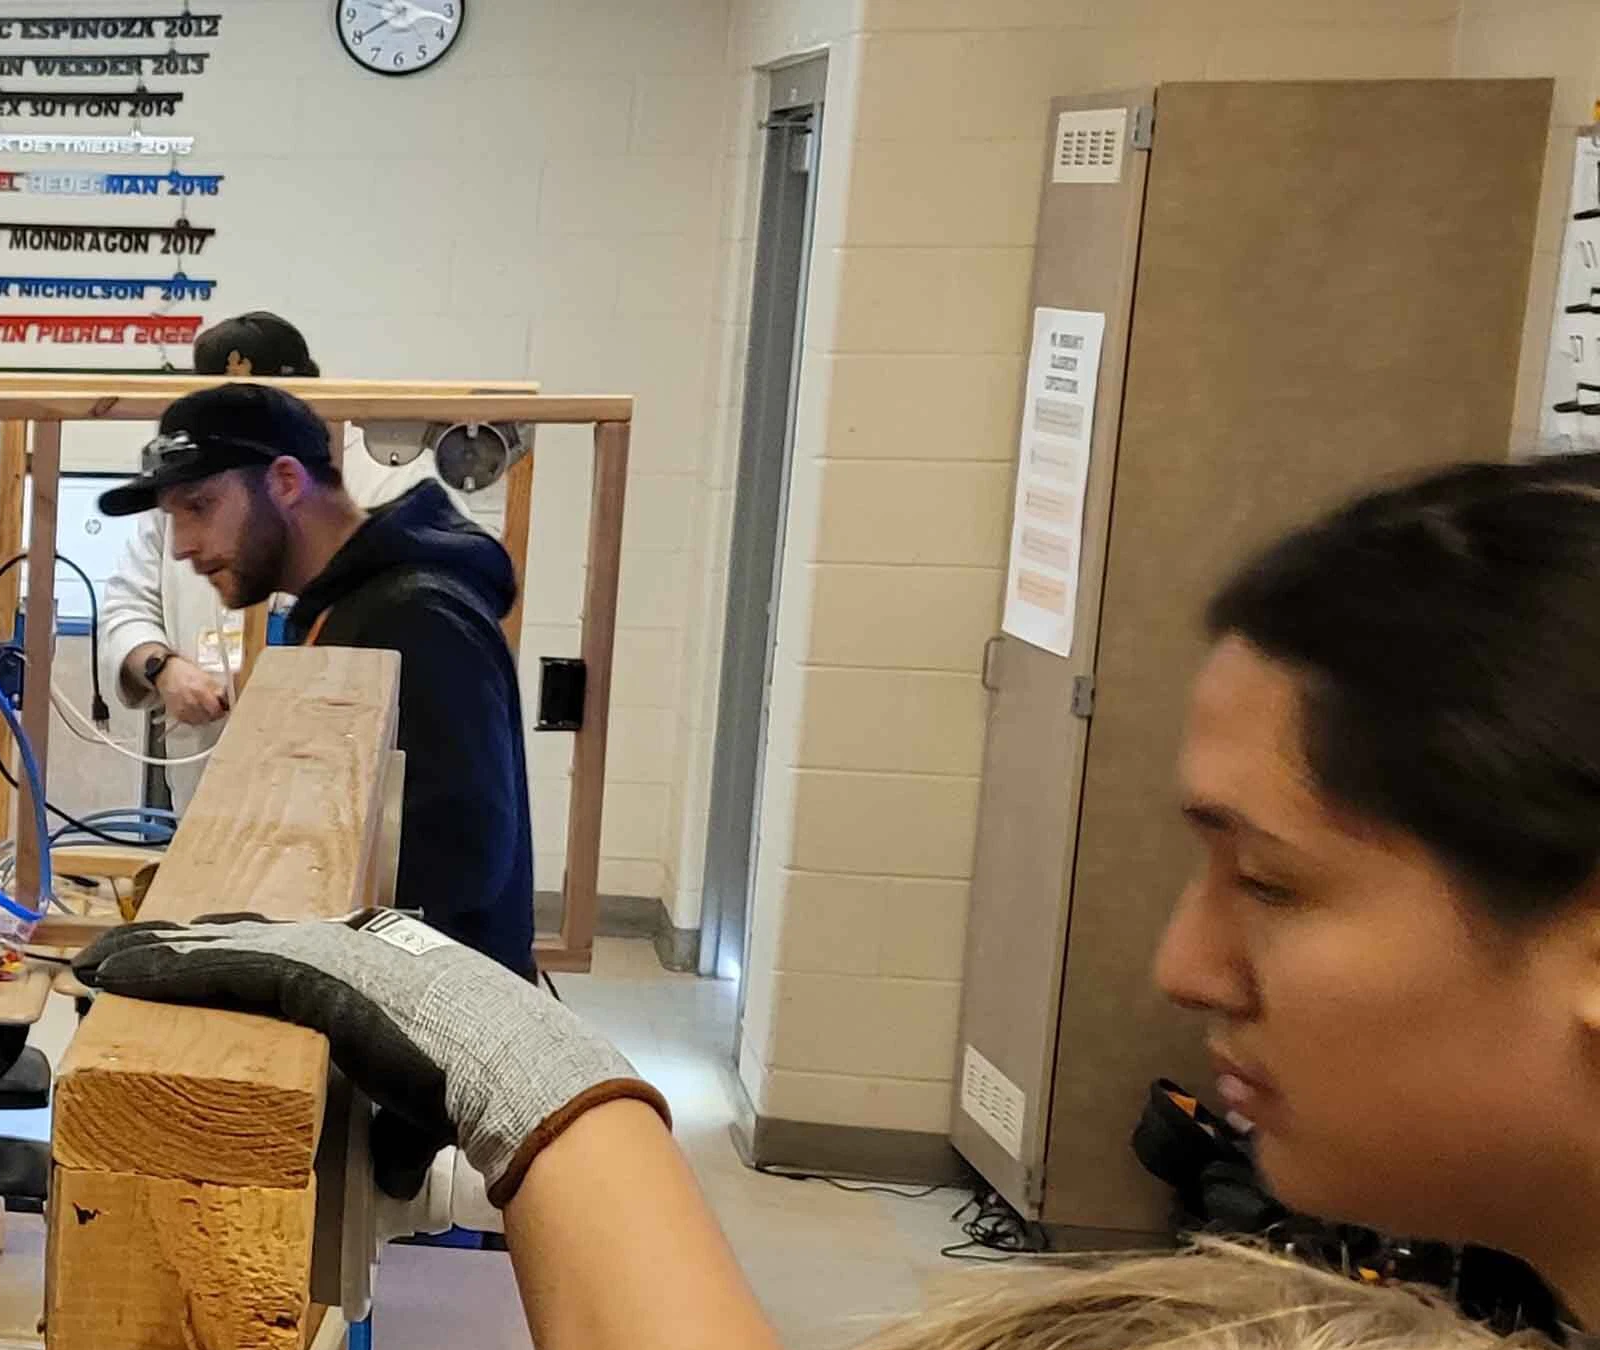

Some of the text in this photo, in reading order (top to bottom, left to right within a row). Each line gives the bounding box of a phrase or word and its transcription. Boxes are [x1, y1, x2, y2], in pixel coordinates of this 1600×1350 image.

[19, 18, 156, 40] ESPINOZA
[162, 17, 221, 38] 2012
[31, 57, 143, 77] WEEDER
[150, 54, 208, 76] 2013
[28, 97, 120, 118] SUTTON
[127, 97, 176, 118] 2014
[167, 176, 220, 196] 2016
[8, 228, 150, 254] MONDRAGON
[159, 232, 209, 256] 2017
[18, 281, 145, 301] NICHOLSON
[160, 283, 212, 302] 2019
